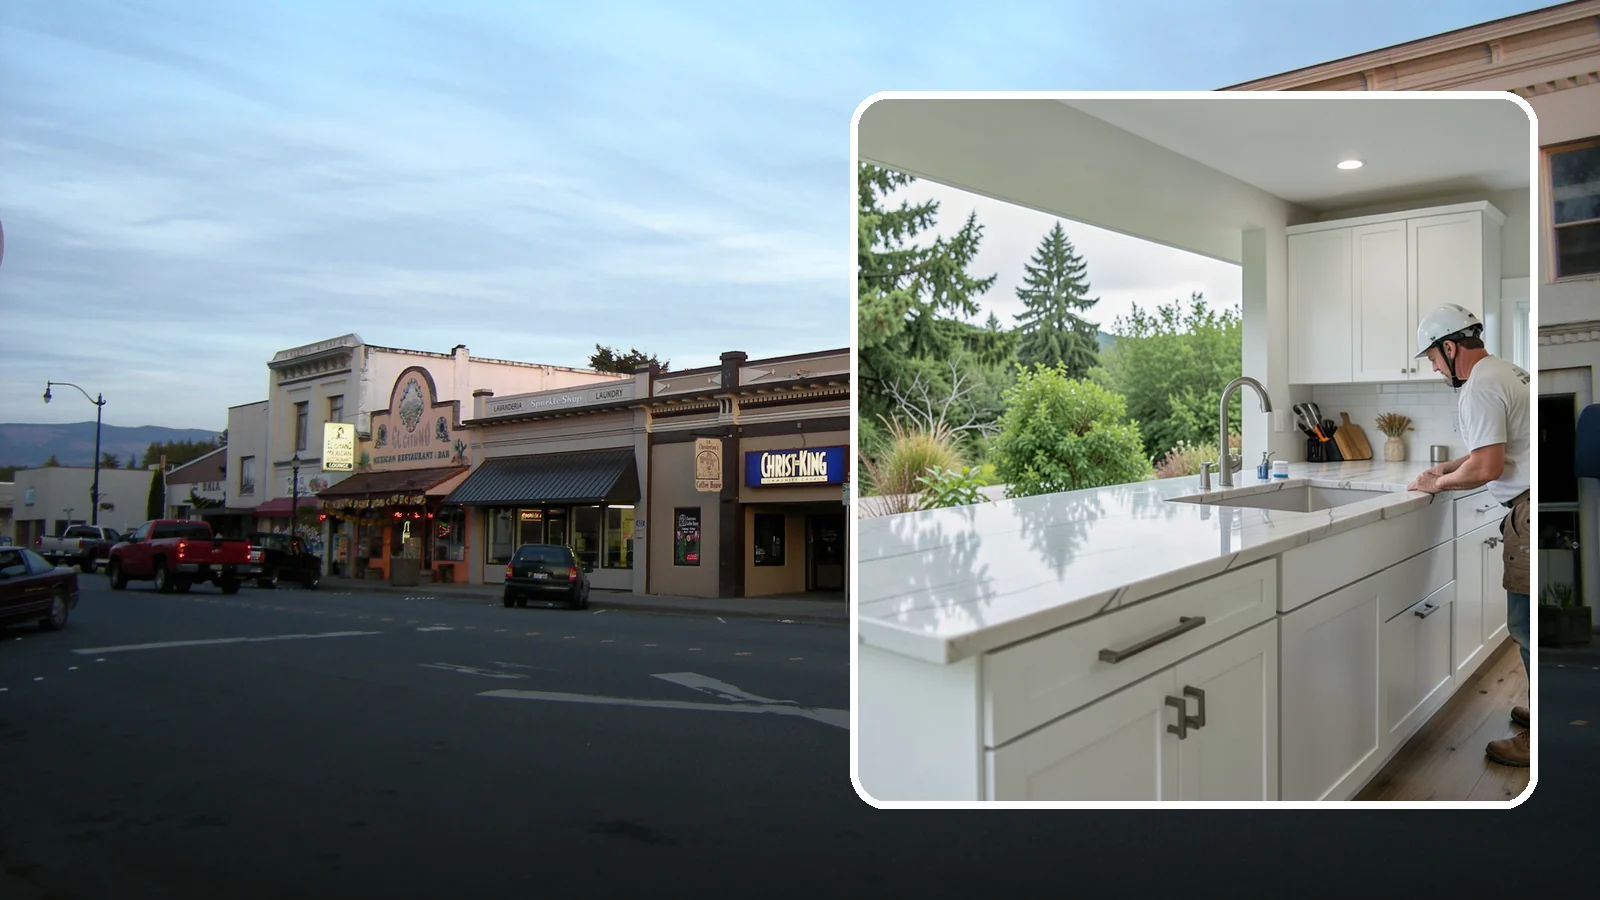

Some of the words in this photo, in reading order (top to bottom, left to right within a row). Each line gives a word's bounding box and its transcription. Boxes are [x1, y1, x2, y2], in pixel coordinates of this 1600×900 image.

[595, 389, 623, 400] LAUNDRY
[493, 402, 522, 412] LAVANDERIA
[531, 396, 560, 408] Sparkle
[561, 394, 583, 404] Shop
[373, 454, 396, 464] MEXICAN
[397, 451, 433, 462] RESTAURANT
[437, 450, 450, 459] BAR
[760, 451, 797, 478] CHRIST
[798, 449, 828, 476] KING
[697, 481, 710, 489] Coffee
[710, 481, 722, 489] House
